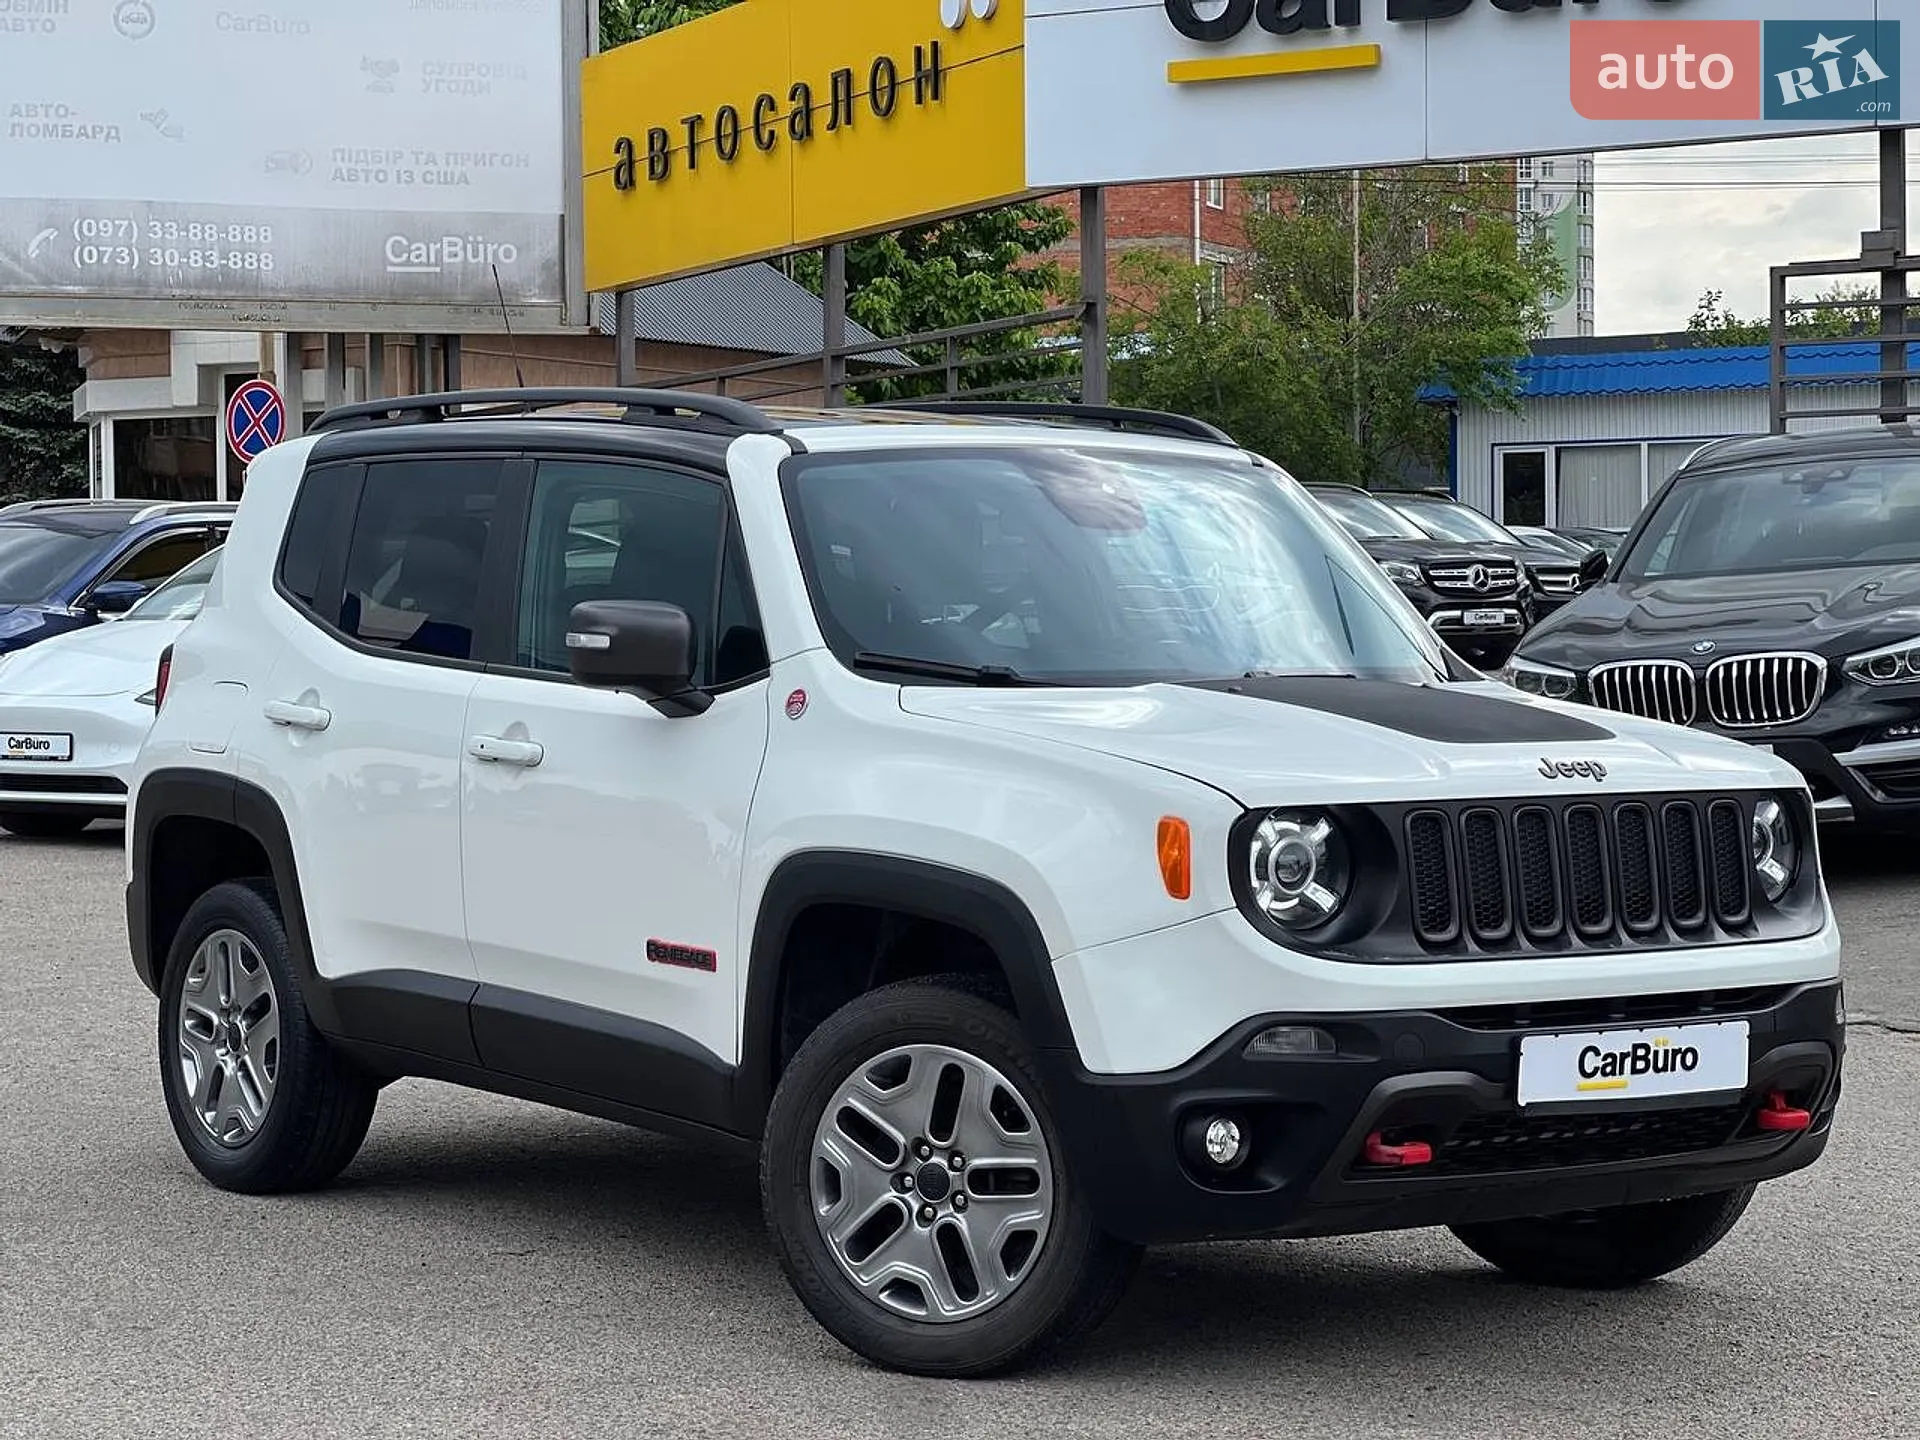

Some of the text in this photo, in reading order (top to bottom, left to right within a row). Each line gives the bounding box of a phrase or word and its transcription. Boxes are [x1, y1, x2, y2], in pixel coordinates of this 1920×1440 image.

[9, 103, 77, 119] АВТО-
[613, 41, 943, 191] автосалон
[9, 122, 121, 143] ЛОМБАРД
[331, 148, 530, 168] ПІДБІР ТА ПРИГОН
[331, 168, 470, 186] АВТО ІЗ США
[73, 218, 272, 244] (097) 33-88-888
[73, 245, 274, 271] (073) 30-83-888
[385, 234, 518, 264] CarBüro
[1538, 757, 1608, 782] Jeep
[1577, 1037, 1699, 1079] CarBüro
